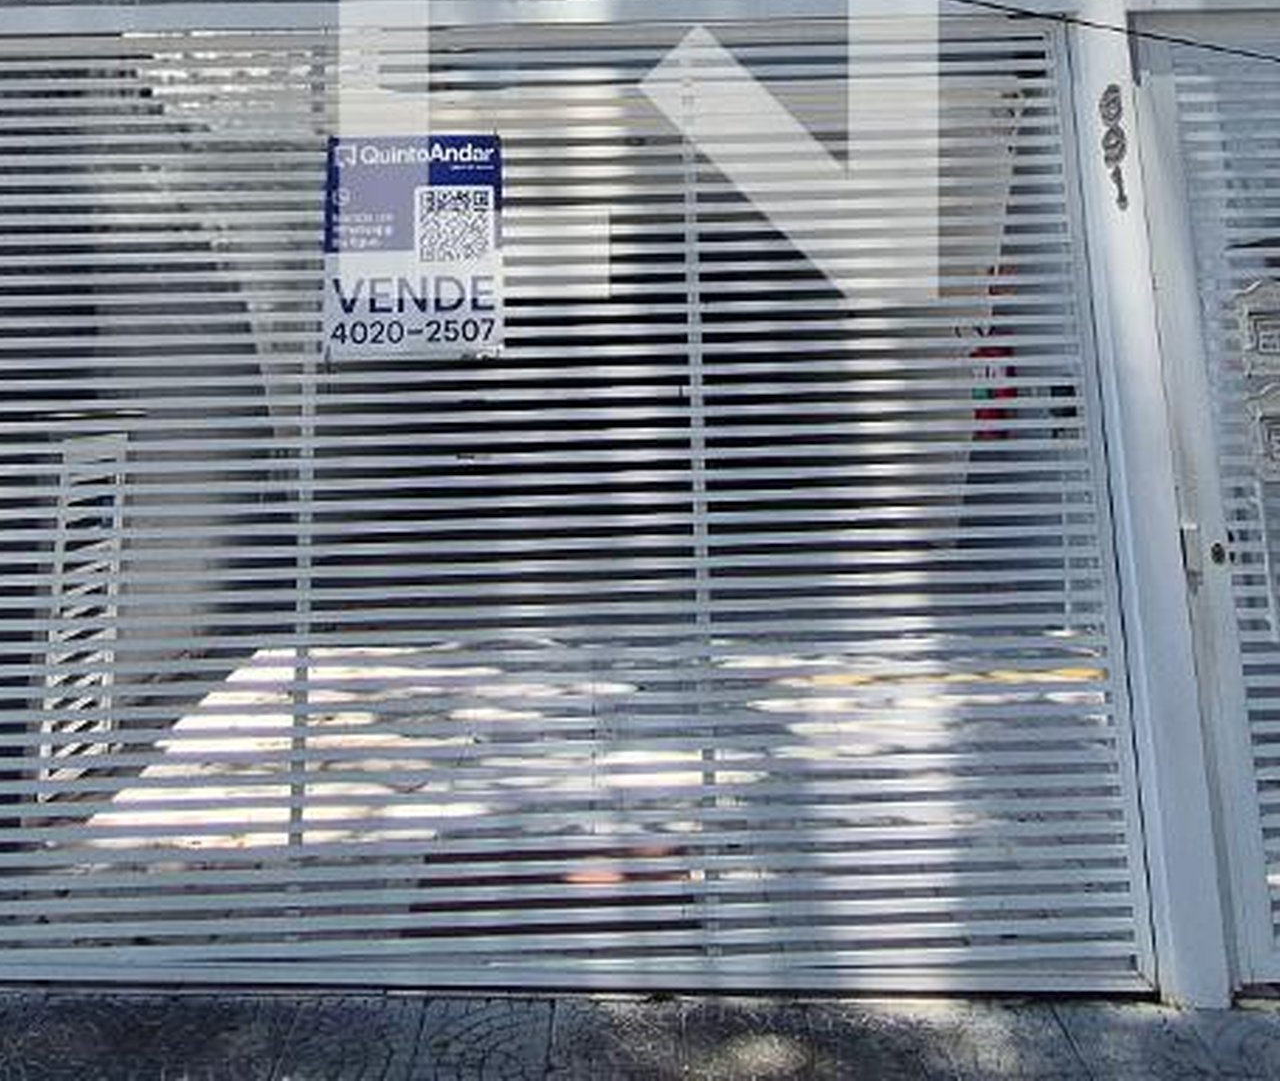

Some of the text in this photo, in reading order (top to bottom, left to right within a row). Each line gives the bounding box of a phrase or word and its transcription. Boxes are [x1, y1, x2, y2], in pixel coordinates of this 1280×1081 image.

[360, 143, 494, 164] QuintoAndar
[333, 275, 495, 314] VENDE
[330, 319, 495, 344] 4020-2507
